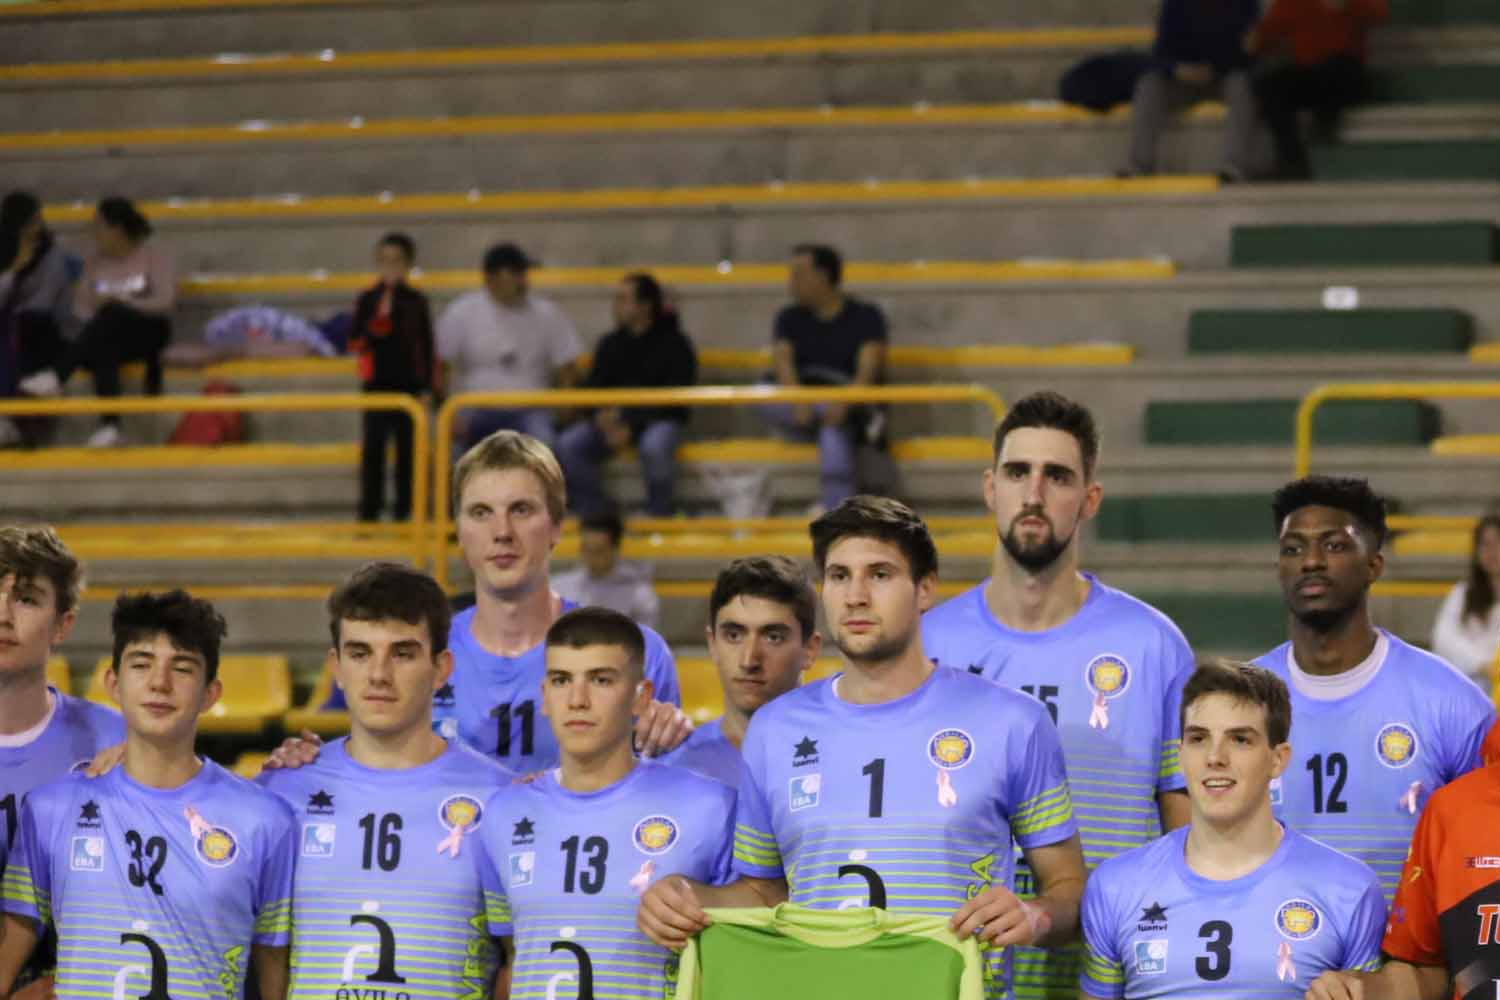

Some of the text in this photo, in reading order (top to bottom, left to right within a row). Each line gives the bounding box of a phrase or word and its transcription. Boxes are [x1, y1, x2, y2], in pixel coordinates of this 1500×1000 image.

[490, 699, 535, 757] 11
[861, 758, 885, 818] 1
[1306, 752, 1348, 814] 12
[124, 829, 168, 896] 32
[358, 812, 403, 872] 16
[559, 834, 609, 895] 13
[1194, 919, 1234, 982] 3
